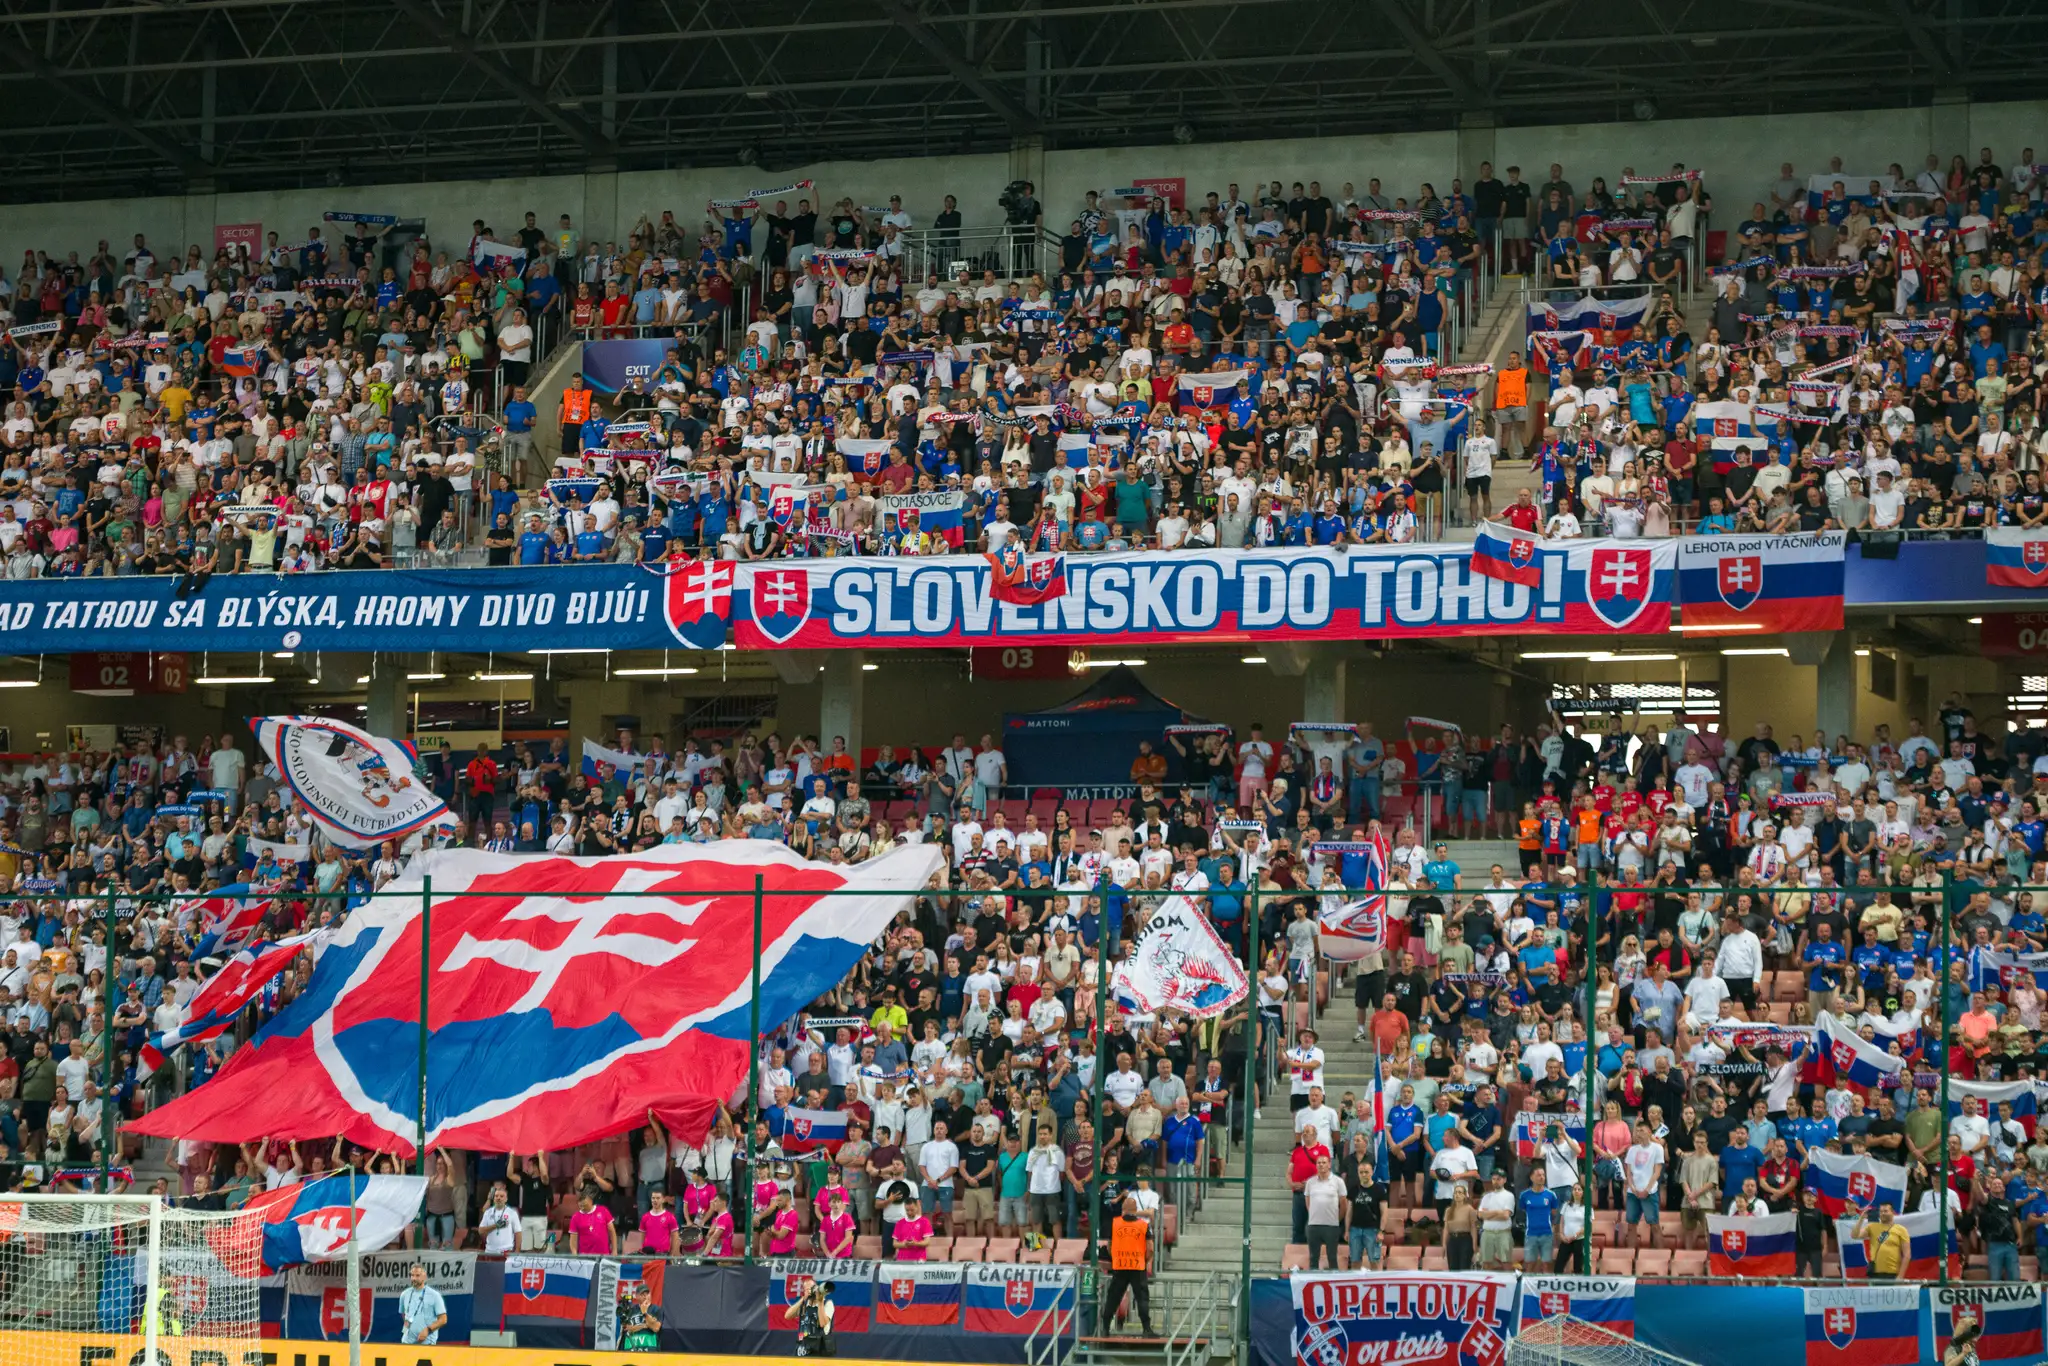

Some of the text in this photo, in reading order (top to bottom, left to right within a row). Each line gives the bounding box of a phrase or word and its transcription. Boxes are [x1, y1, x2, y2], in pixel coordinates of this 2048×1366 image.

[868, 205, 892, 213] SLOVA
[222, 228, 256, 239] SECTOR
[10, 322, 58, 336] SLOVENSKO
[1384, 356, 1436, 367] SOVENSKO
[626, 365, 651, 376] EXIT
[1440, 365, 1478, 375] LOVENSKO
[228, 505, 279, 513] SLOVENSKO
[1685, 535, 1842, 554] LEHOTA pod VTÁČNIKOM
[1240, 560, 1331, 626] DO
[0, 582, 650, 631] AD TATROU SA BLÝSKA, HROMY DIVO BIJÚ!
[2014, 614, 2048, 625] SECTO
[2018, 627, 2048, 651] 04
[1002, 648, 1034, 669] 03
[101, 666, 129, 686] 02
[164, 667, 182, 688] 02
[1570, 700, 1620, 709] SLOVAKIA
[1027, 719, 1070, 728] MATTONI
[1588, 719, 1610, 729] EXI
[419, 736, 444, 746] EXIT
[290, 755, 350, 821] SLOVENSKEJ
[1065, 787, 1137, 801] MATTON
[1655, 799, 1664, 814] 7
[1313, 844, 1372, 852] SLOVENSK
[1448, 974, 1497, 983] SLOVAKIA
[806, 1019, 860, 1027] SLOVENSKO
[1709, 1064, 1763, 1074] SLOVAKIA
[361, 1256, 436, 1278] Slovenu
[441, 1260, 466, 1278] o.z.
[978, 1265, 1064, 1283] ČACHTICE
[923, 1269, 957, 1281] STRÁŇAVY
[1536, 1278, 1620, 1293] PÚCHOV
[1302, 1276, 1507, 1328] OPATOVÁ
[1938, 1284, 2037, 1306] GRINAVA
[597, 1263, 617, 1343] KANIANKA
[1357, 1339, 1391, 1364] on
[1393, 1329, 1449, 1360] tour
